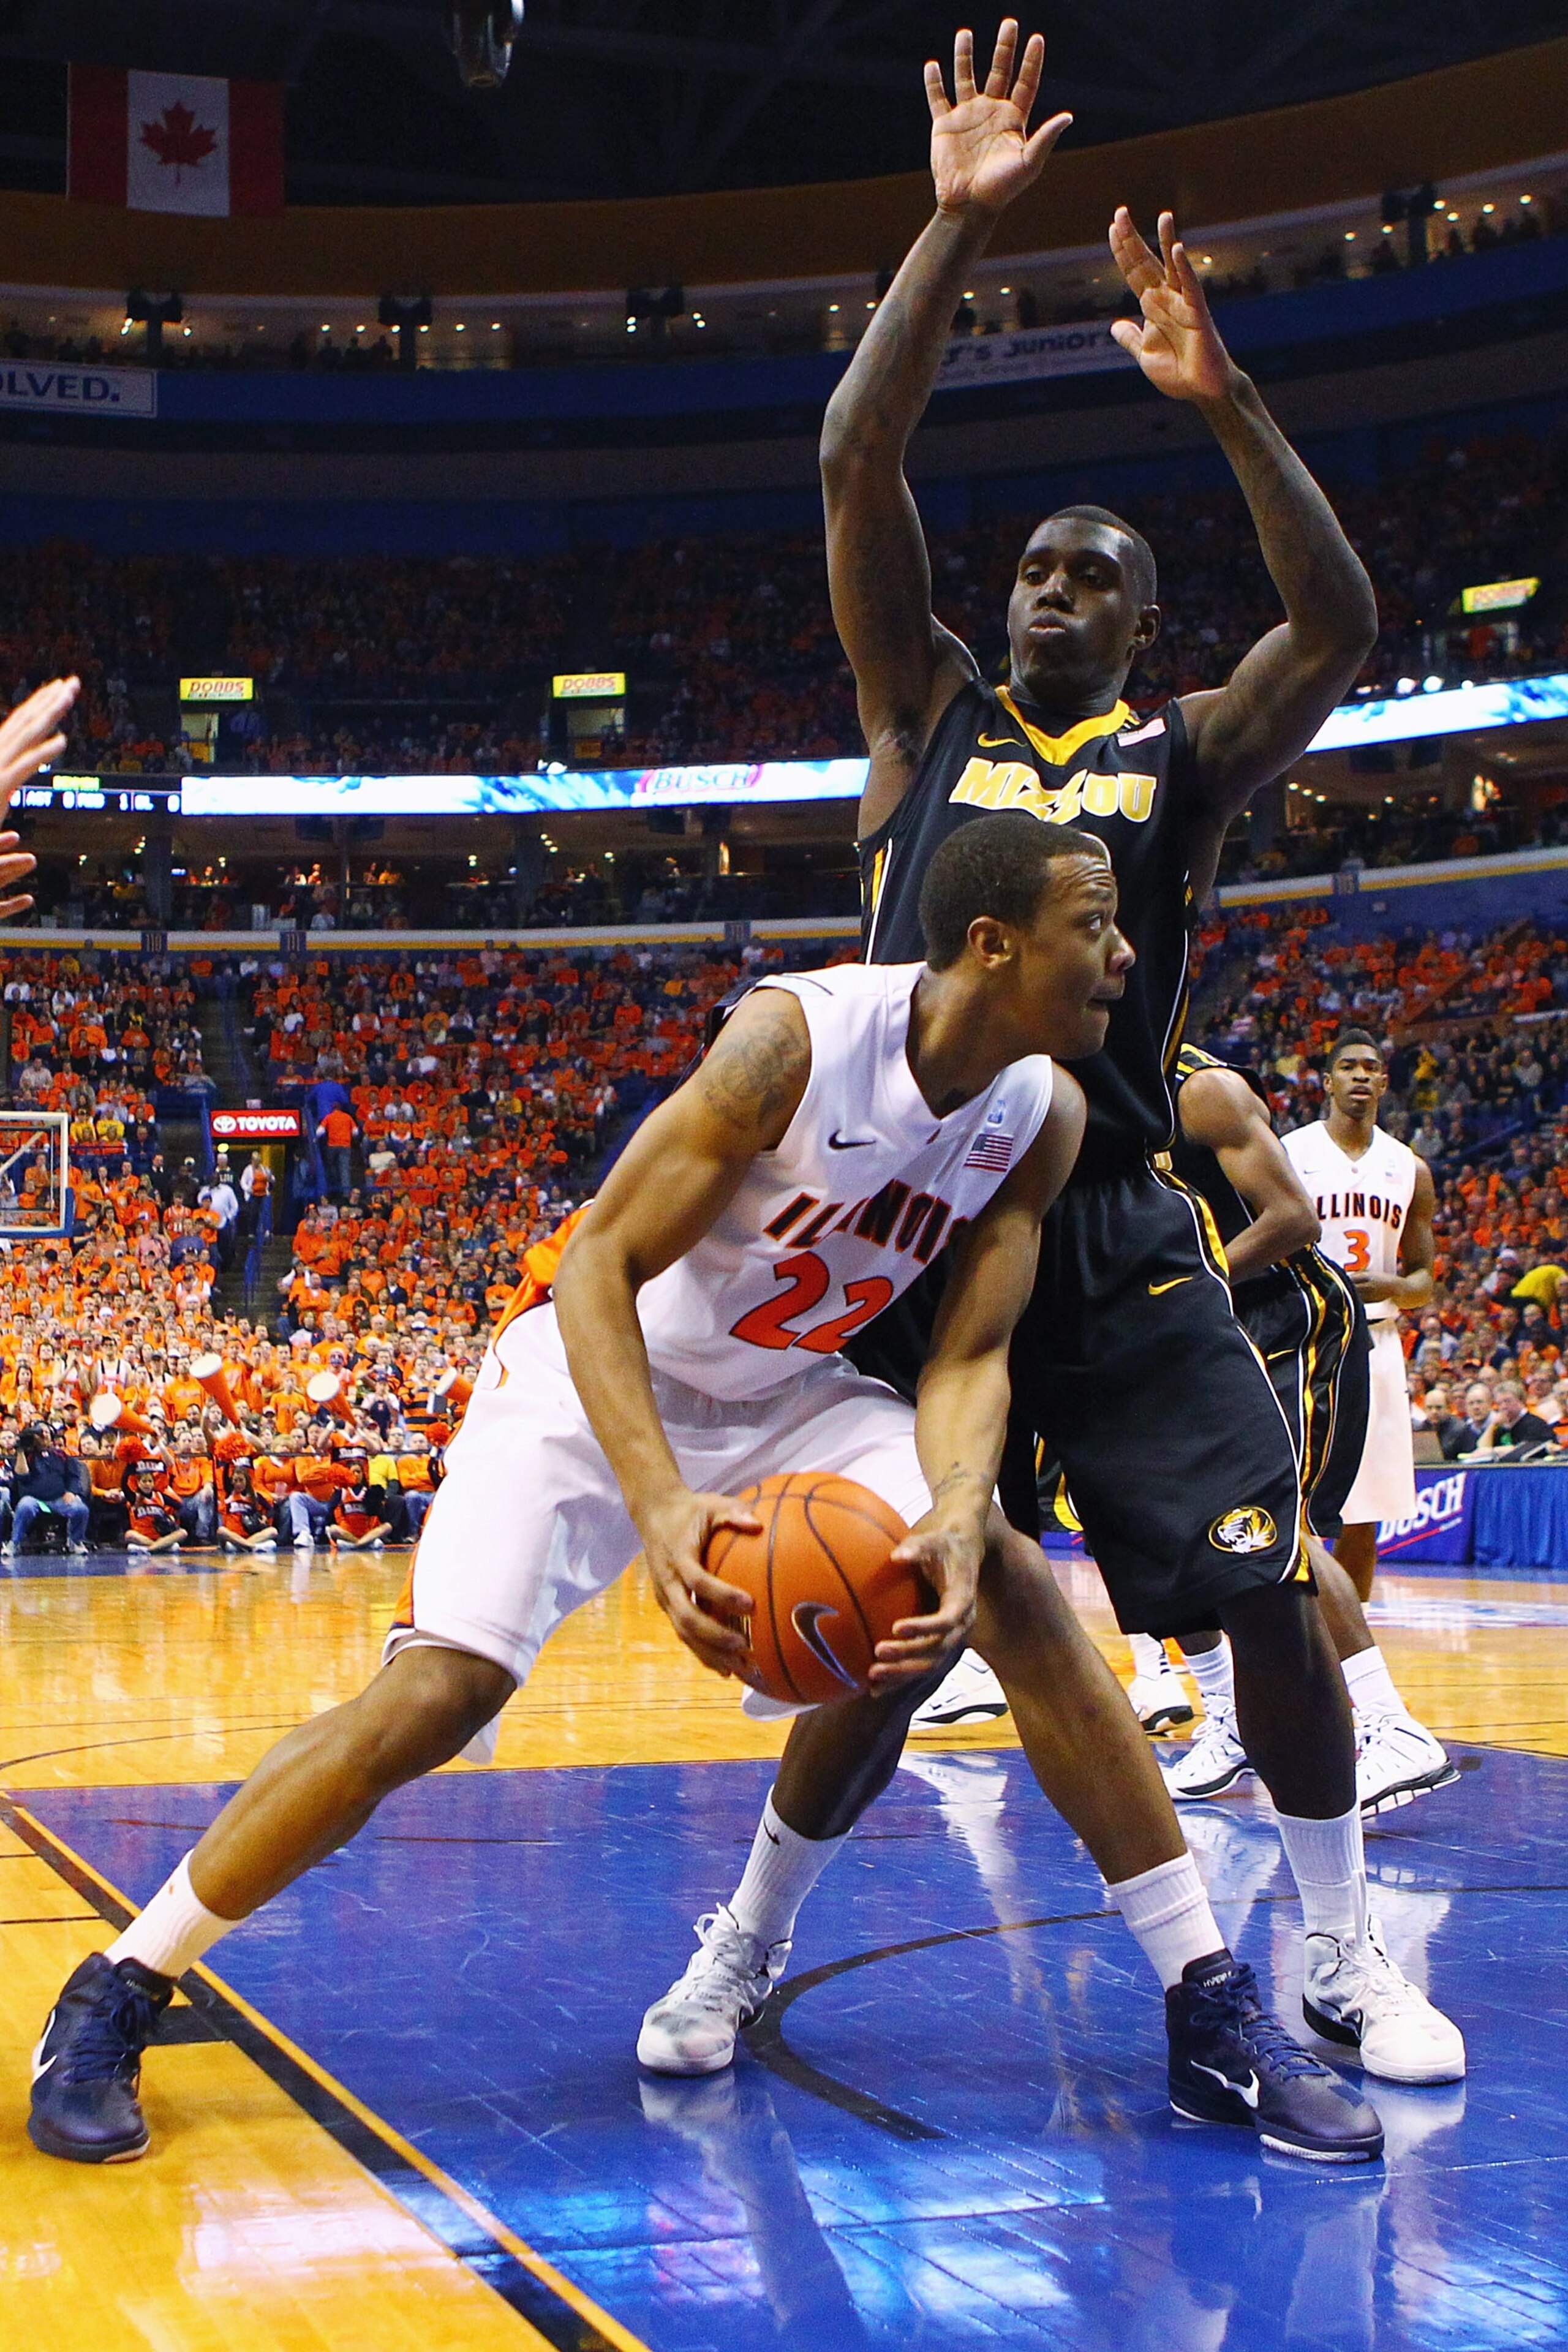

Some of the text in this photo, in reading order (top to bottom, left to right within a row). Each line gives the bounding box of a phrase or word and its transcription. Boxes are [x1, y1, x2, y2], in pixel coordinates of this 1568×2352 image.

[0, 371, 120, 402] LVED.
[654, 770, 751, 790] BUSCH
[236, 1115, 298, 1131] TOYOTA
[763, 1178, 970, 1264] ILNOI
[1317, 1193, 1402, 1229] LLINOIS
[1343, 1229, 1371, 1272] 3
[729, 1251, 894, 1354] 22
